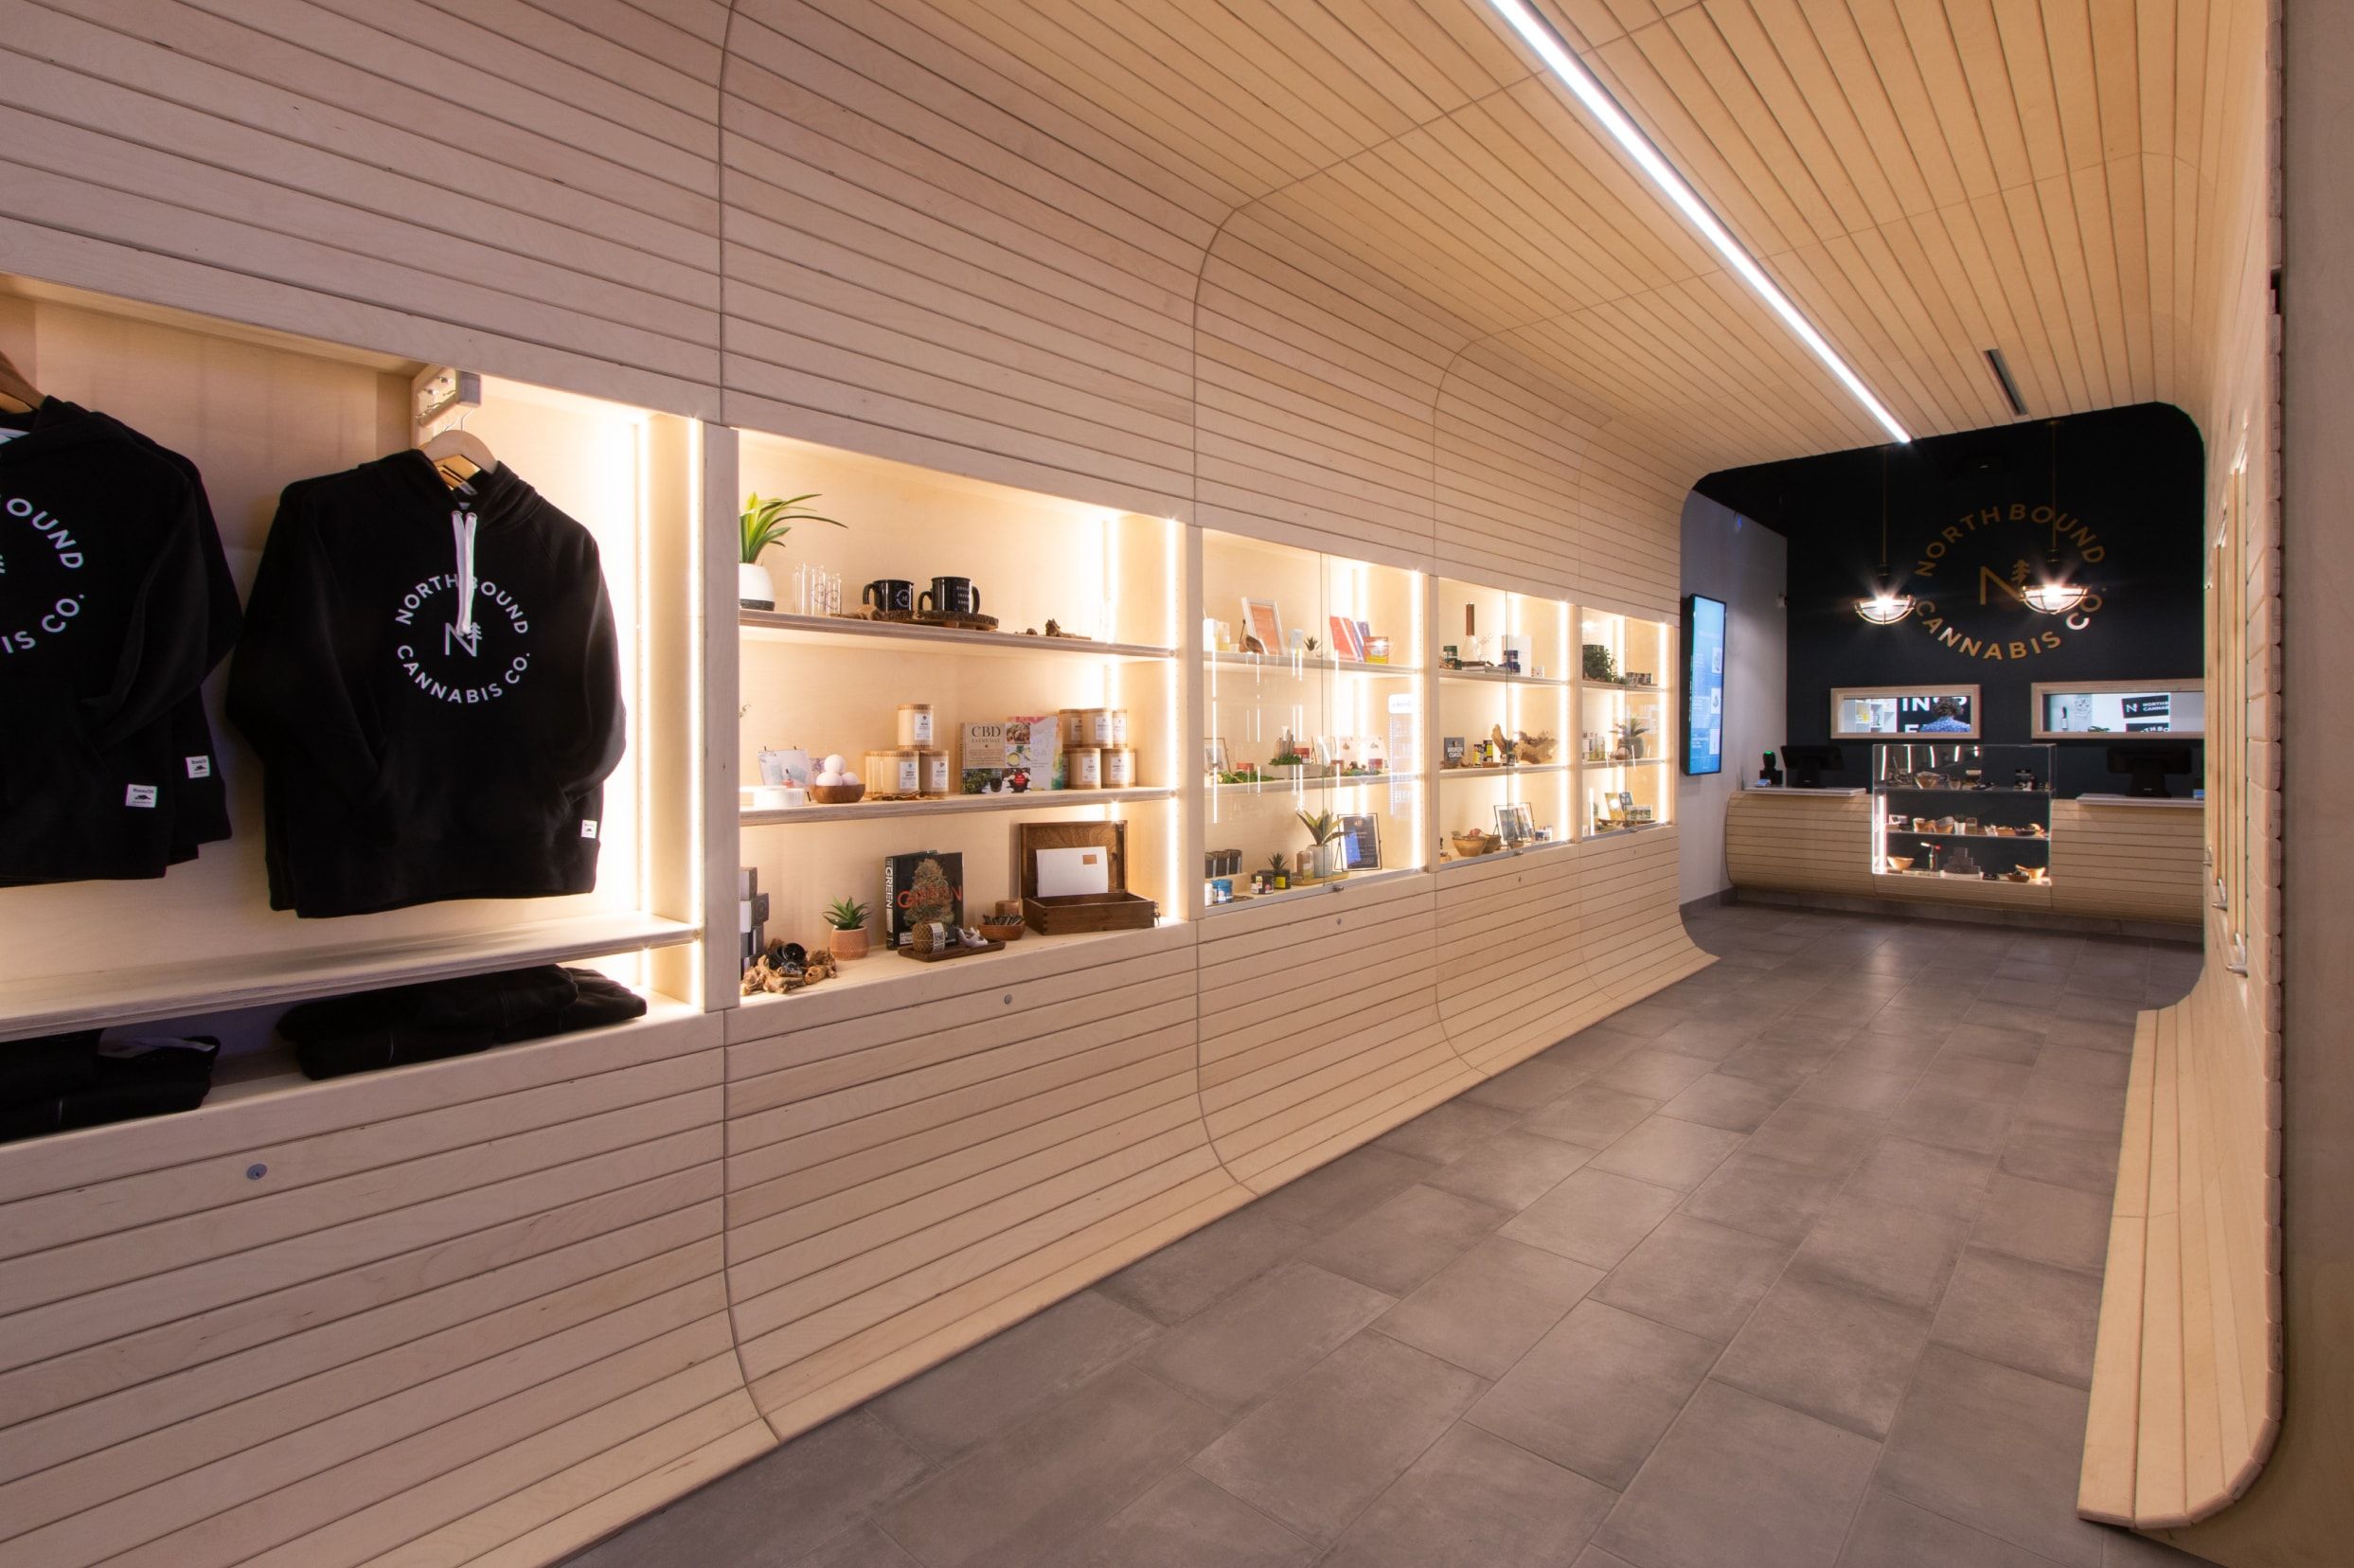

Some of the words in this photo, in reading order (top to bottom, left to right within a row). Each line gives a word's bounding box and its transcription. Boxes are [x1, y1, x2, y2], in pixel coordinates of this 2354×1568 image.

[42, 594, 85, 633] CO.
[1916, 600, 2061, 660] CANNABIS
[397, 645, 503, 704] CANNABIS
[505, 652, 530, 684] CO.
[972, 725, 1001, 738] CBD
